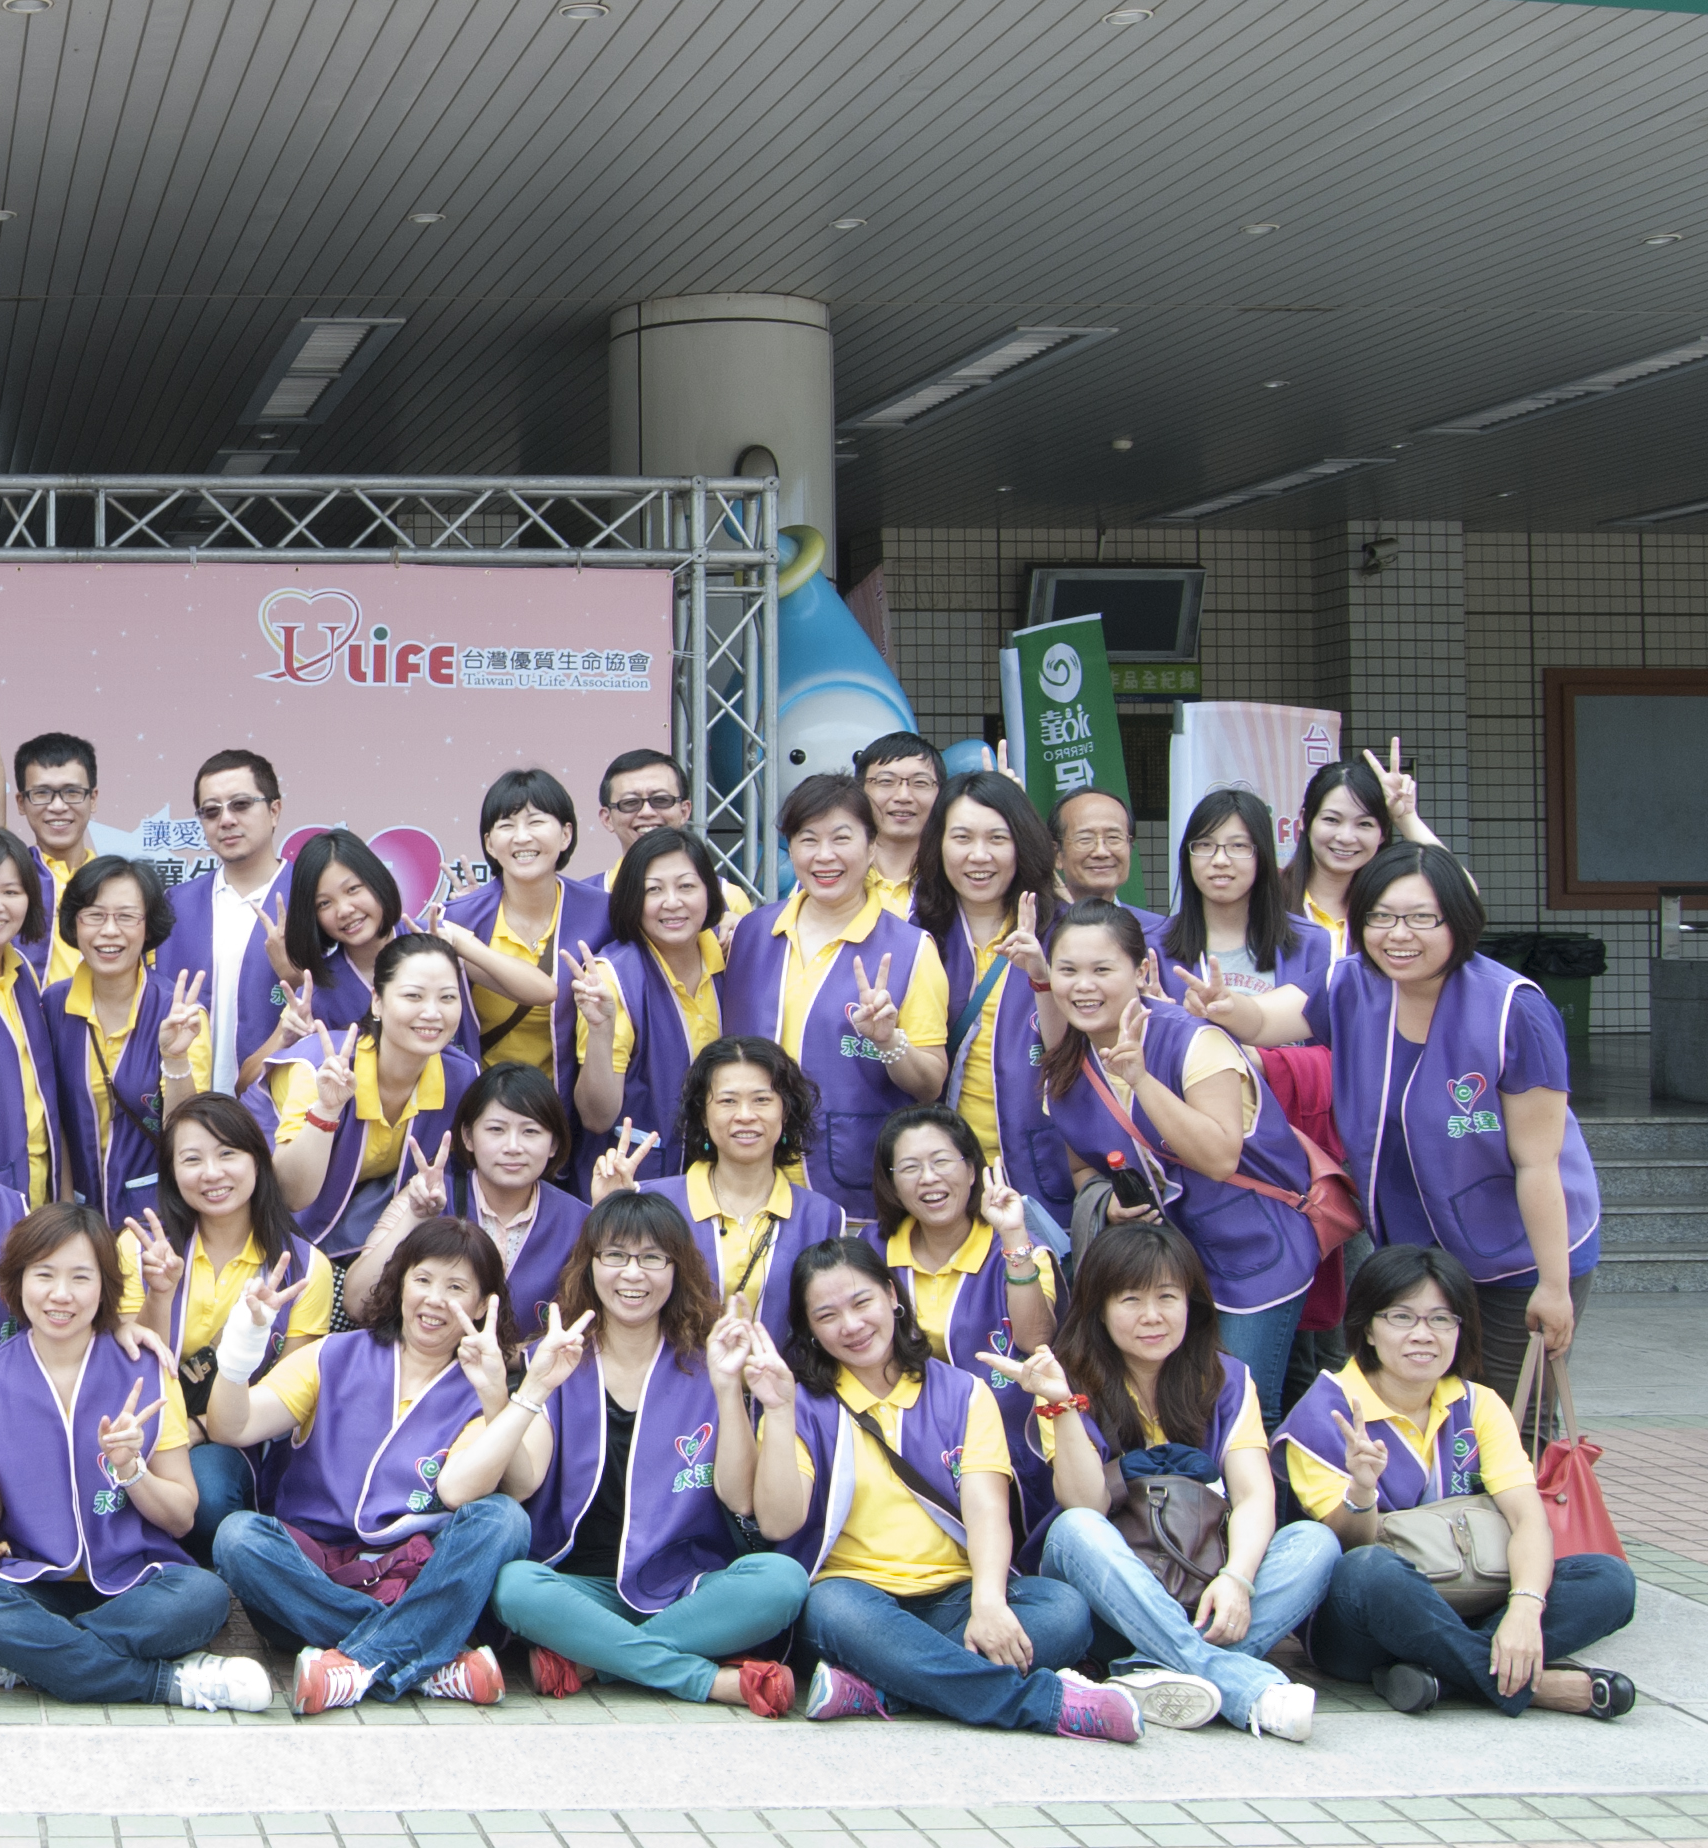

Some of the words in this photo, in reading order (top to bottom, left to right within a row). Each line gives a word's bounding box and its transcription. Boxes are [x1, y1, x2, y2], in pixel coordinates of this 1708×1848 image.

[462, 650, 651, 672] 台灣優質生命協會
[463, 673, 513, 686] Taiwan
[519, 674, 566, 688] U-Life
[569, 674, 649, 689] Association
[142, 820, 209, 848] 讓愛
[1448, 1110, 1501, 1138] 永達
[671, 1462, 714, 1493] 永達
